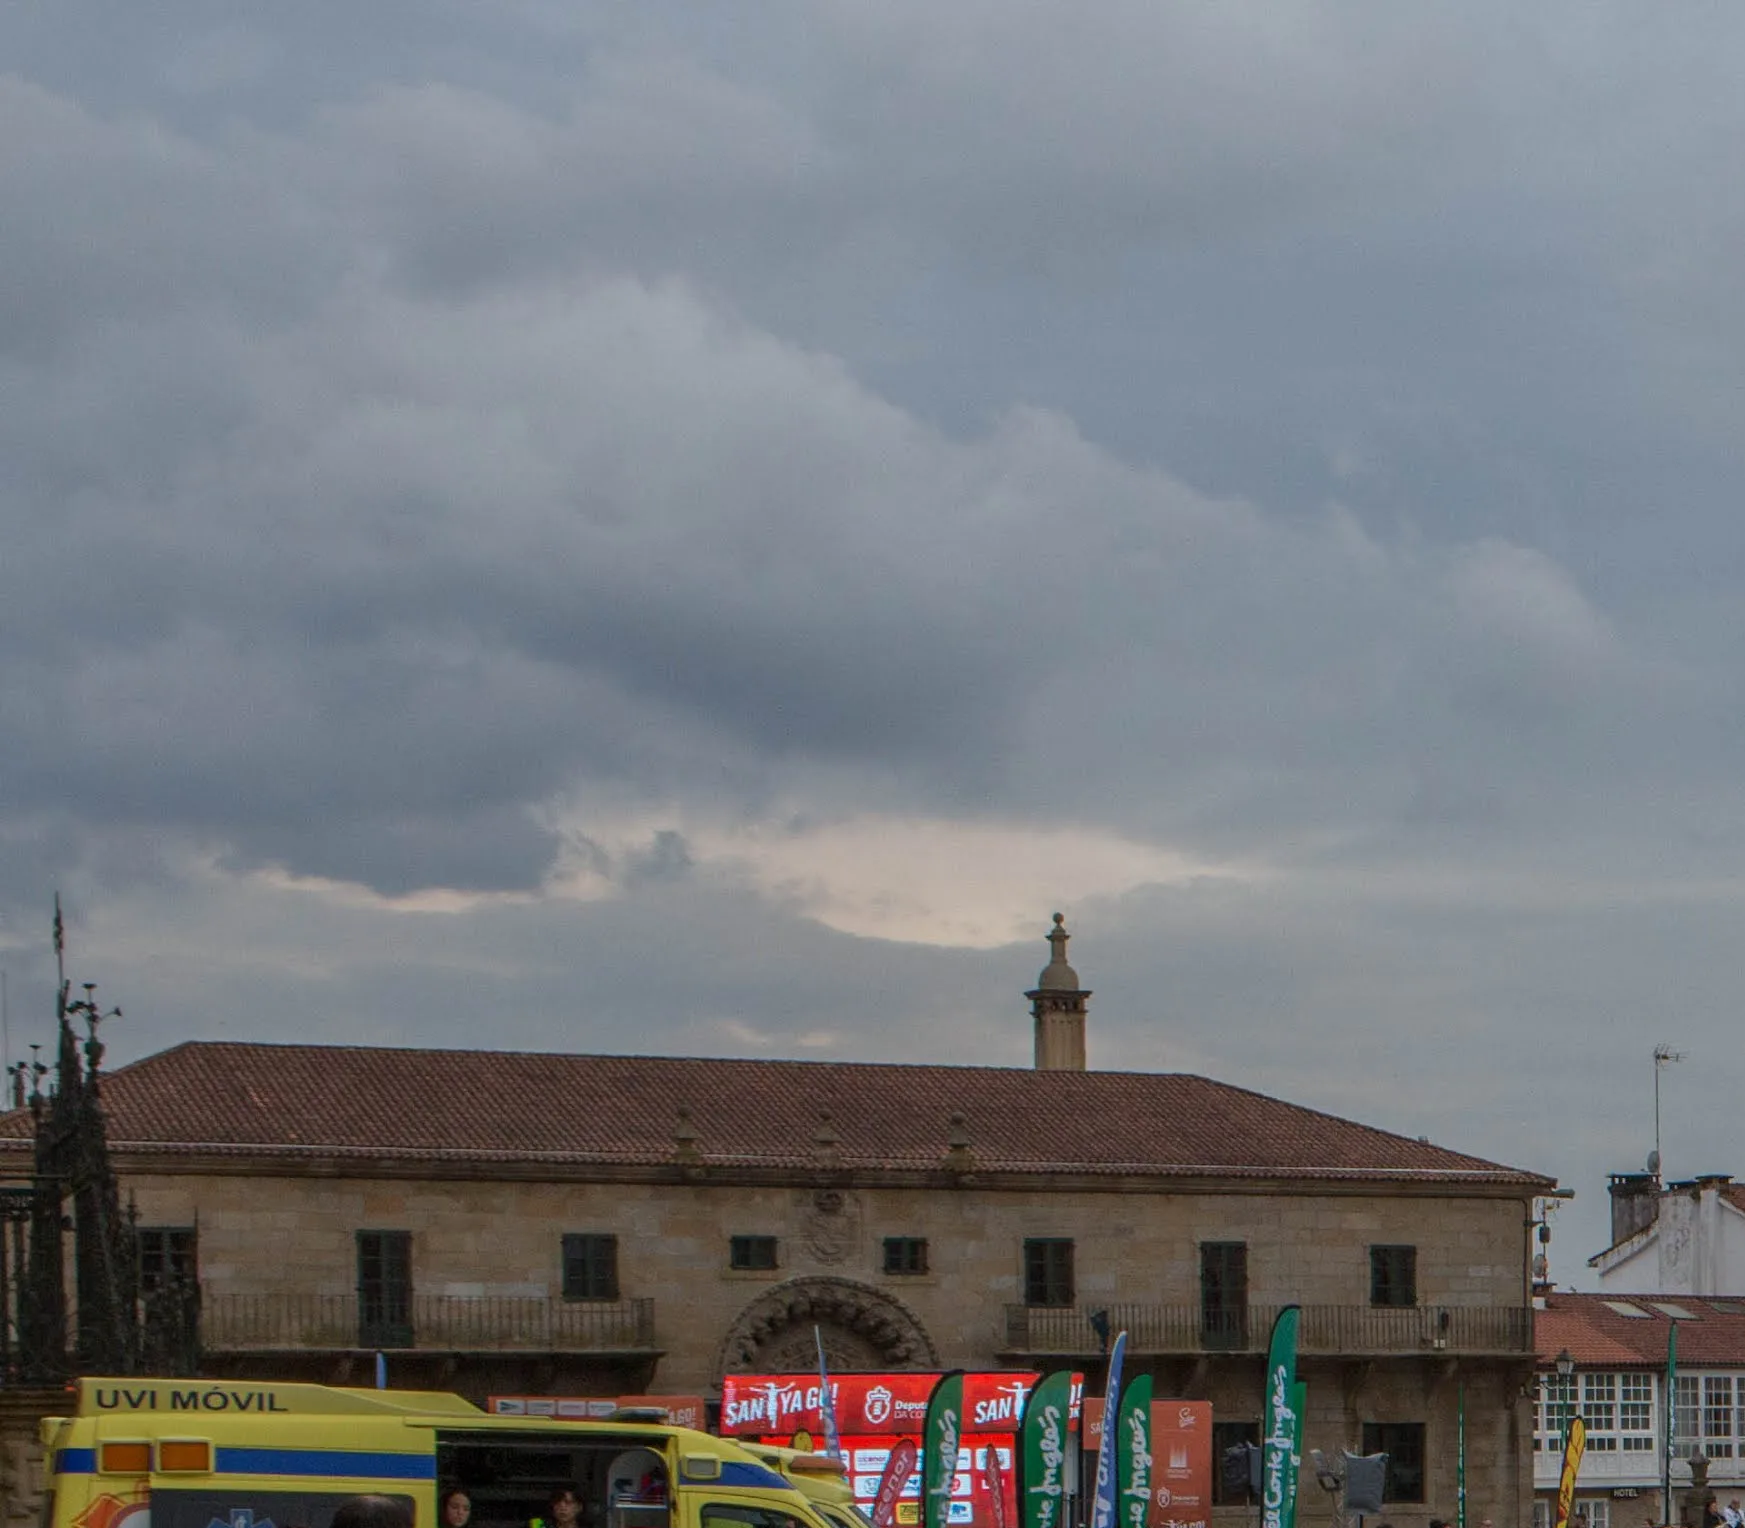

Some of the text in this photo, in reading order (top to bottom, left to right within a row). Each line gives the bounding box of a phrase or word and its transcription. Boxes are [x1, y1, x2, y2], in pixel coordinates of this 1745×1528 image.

[95, 1386, 289, 1412] UVI MÓVIL
[1264, 1365, 1296, 1450] Inglés
[1030, 1406, 1063, 1496] Inglés
[1124, 1408, 1153, 1500] Inglés
[1264, 1451, 1283, 1508] Corte
[1613, 1488, 1639, 1498] HOTEL
